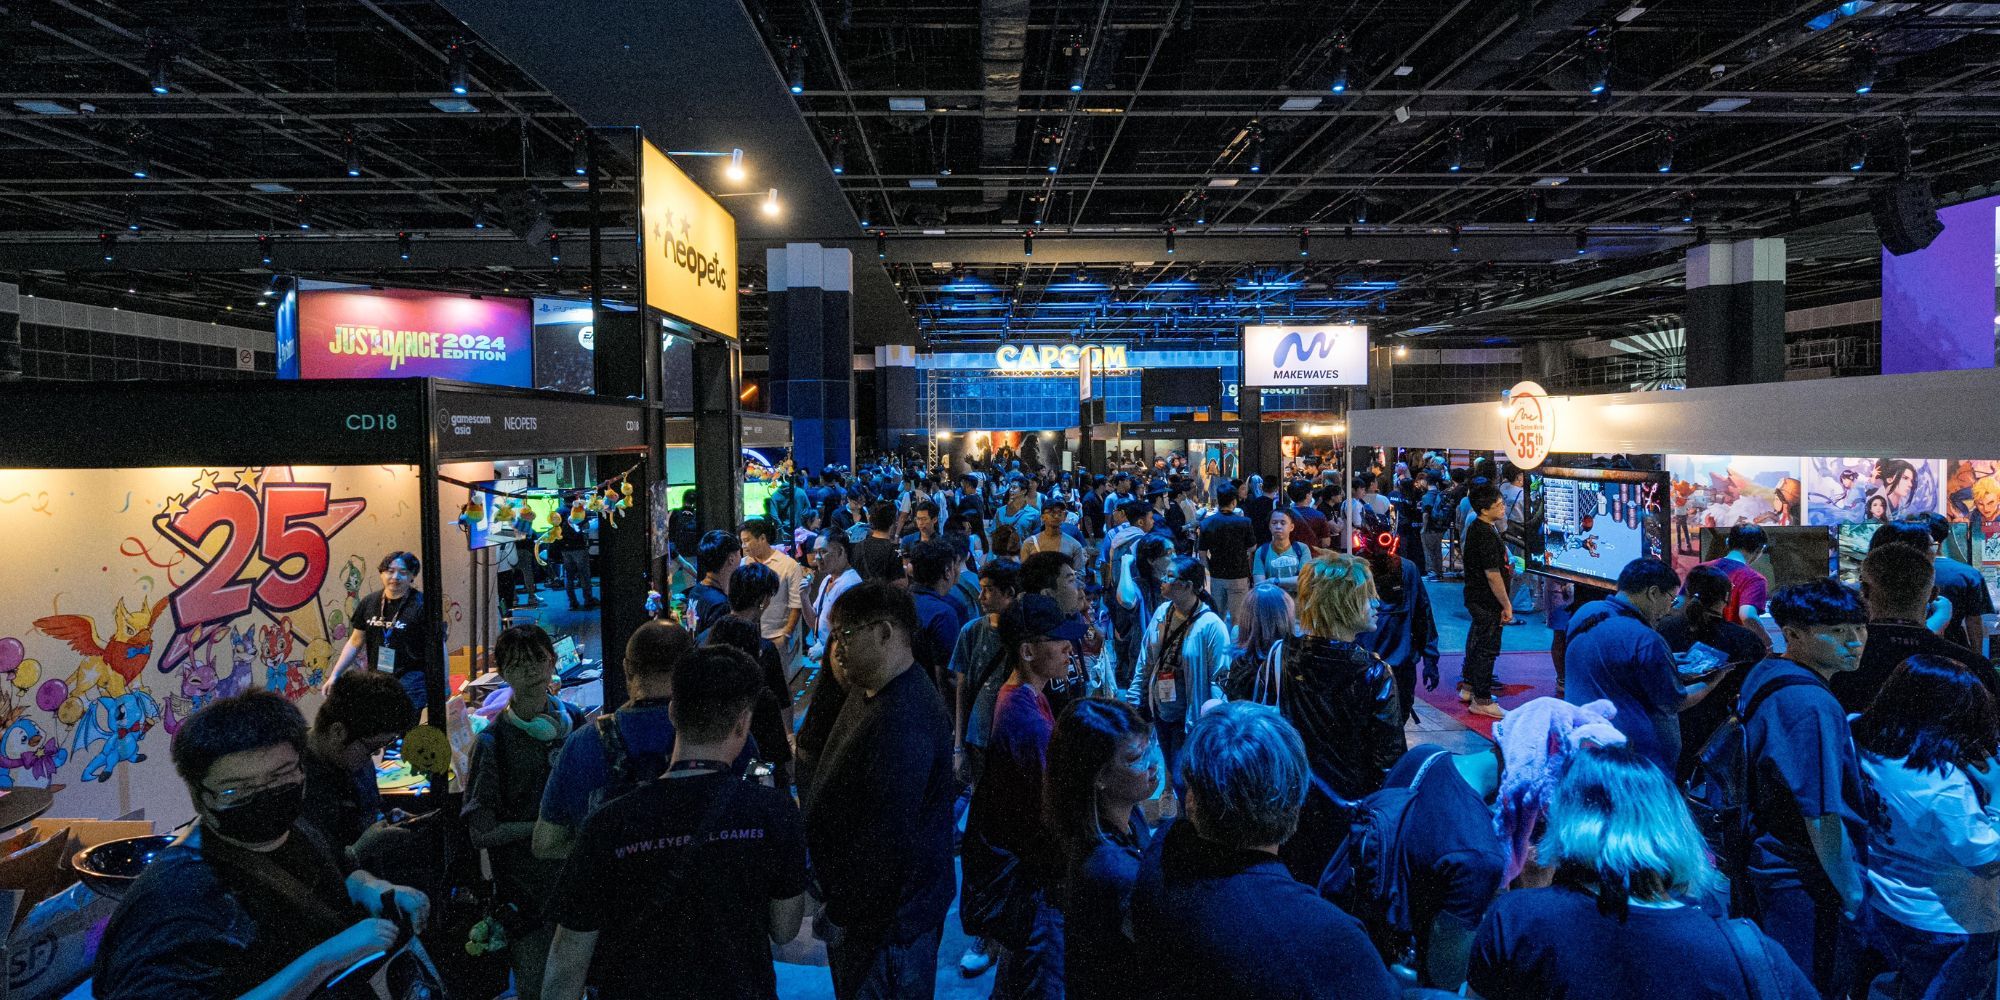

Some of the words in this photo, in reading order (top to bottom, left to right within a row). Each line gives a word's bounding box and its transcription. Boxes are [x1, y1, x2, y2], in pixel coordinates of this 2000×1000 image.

[664, 230, 727, 291] neopets
[329, 325, 381, 355] JUST
[381, 329, 441, 371] DANCE
[442, 333, 506, 350] 2024
[442, 349, 507, 361] EDITION
[995, 344, 1128, 369] CAPCOM
[1273, 369, 1339, 379] MAKEWAVES
[345, 414, 398, 430] CD18
[450, 415, 491, 425] gamescom
[504, 416, 538, 431] NEOPETS
[625, 421, 640, 431] CD18
[454, 425, 472, 436] asia
[1517, 432, 1544, 459] 35th
[166, 481, 331, 634] 25
